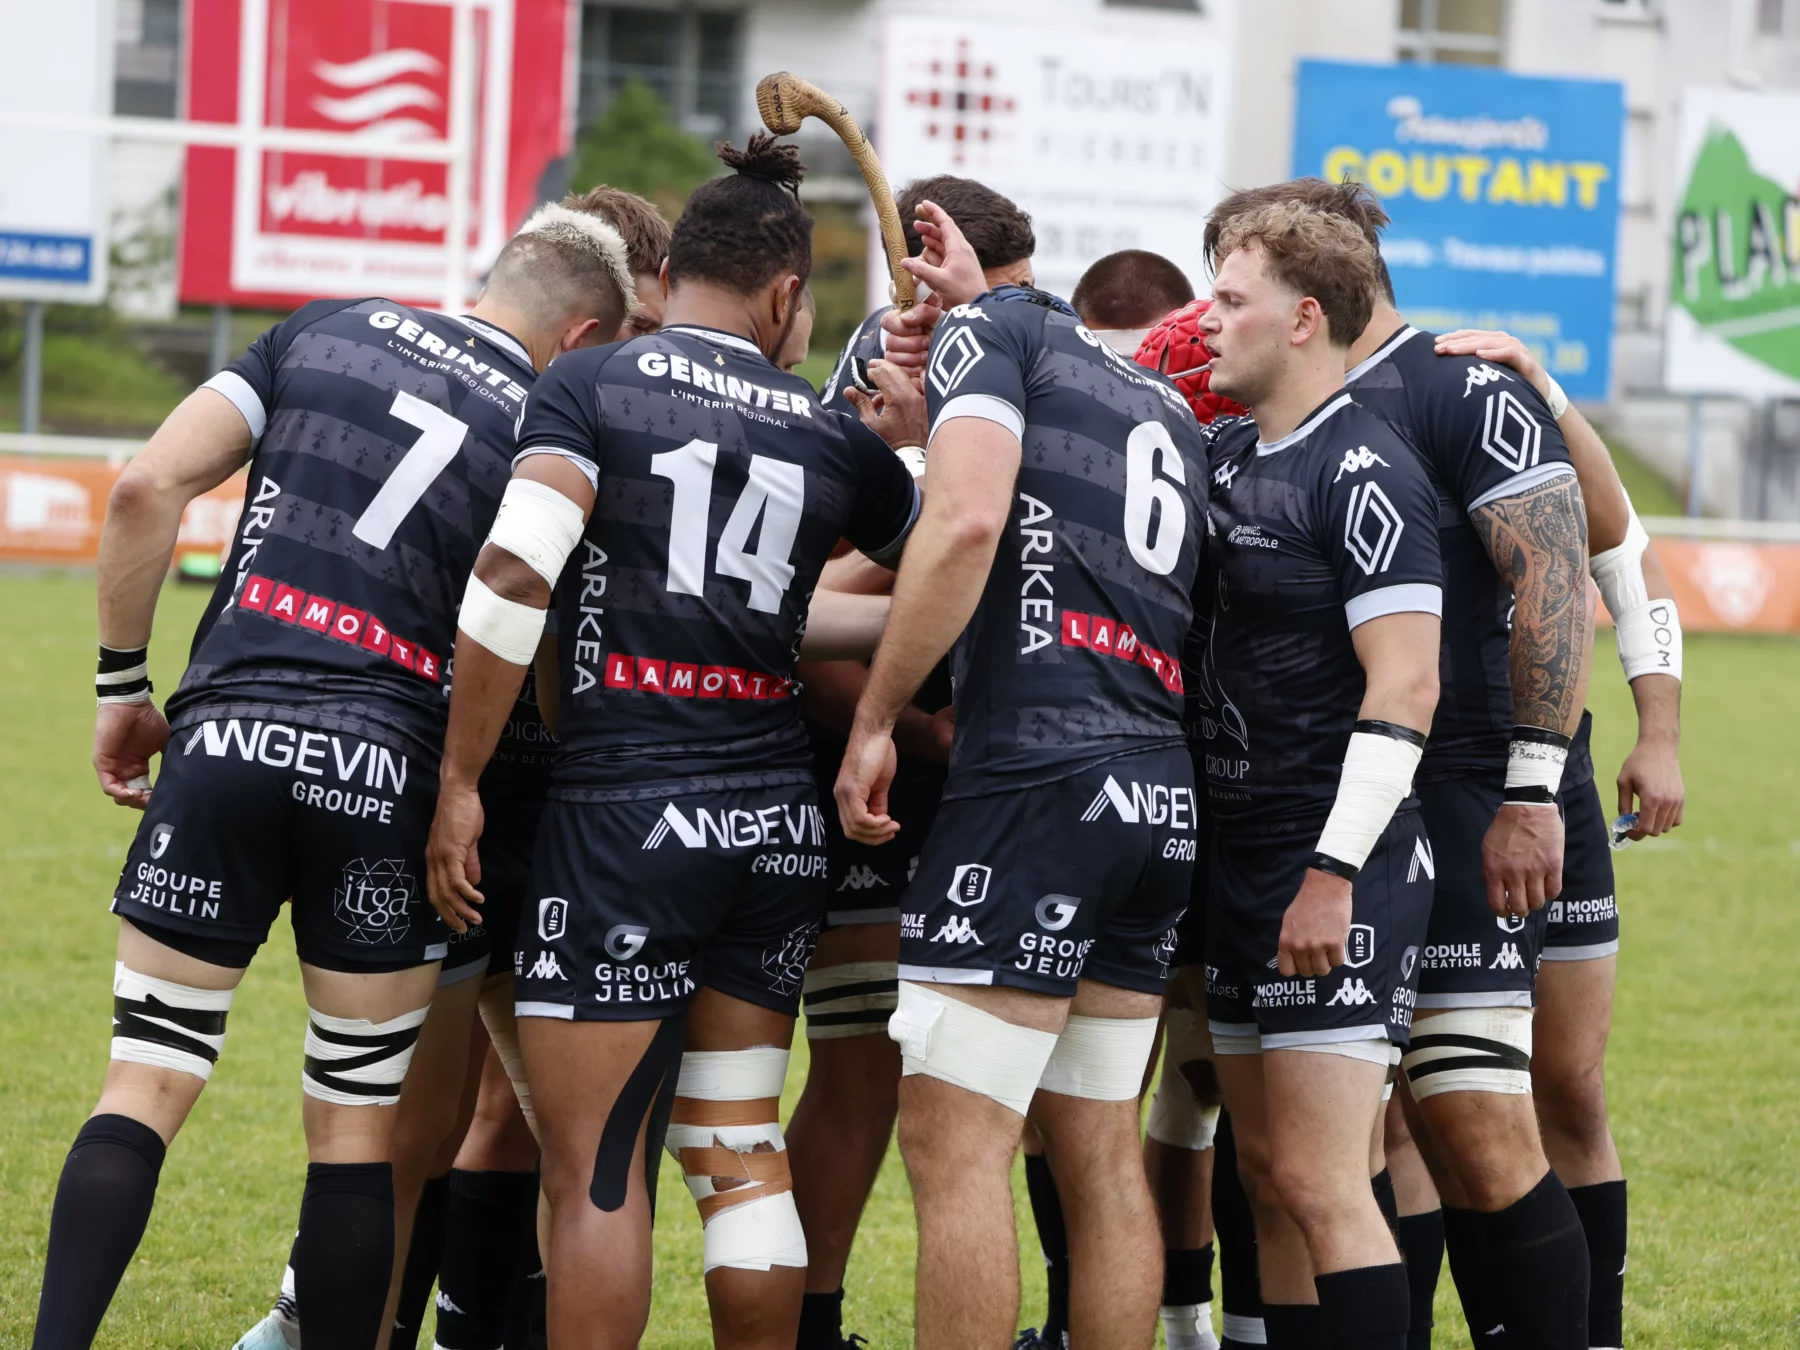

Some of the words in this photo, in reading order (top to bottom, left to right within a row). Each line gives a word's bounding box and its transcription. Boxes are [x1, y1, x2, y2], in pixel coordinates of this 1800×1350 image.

[772, 83, 784, 123] 1961
[1325, 147, 1608, 207] COUTANT
[388, 340, 450, 371] L'INTERIM
[453, 369, 511, 412] RÉGIONAL
[637, 352, 812, 418] GERINTER
[671, 389, 733, 410] L'INTERIM
[352, 390, 469, 550] 7
[1124, 421, 1186, 575] 6
[650, 438, 804, 615] 14
[1020, 492, 1054, 655] ARKEA
[248, 583, 434, 675] LAMOTTE
[572, 538, 608, 694] ARKEA
[1650, 606, 1672, 667] DOM
[183, 719, 408, 795] ANGEVIN
[292, 780, 394, 824] GROUPE
[130, 883, 219, 919] JEULIN
[137, 862, 222, 899] GROUPE
[345, 874, 410, 927] itga
[1567, 895, 1614, 913] MODULE
[1567, 908, 1614, 923] CREATION
[595, 960, 690, 982] GROUPE
[1422, 943, 1481, 959] ODULE
[595, 977, 695, 1002] JEULIN
[1256, 980, 1316, 997] MODULE
